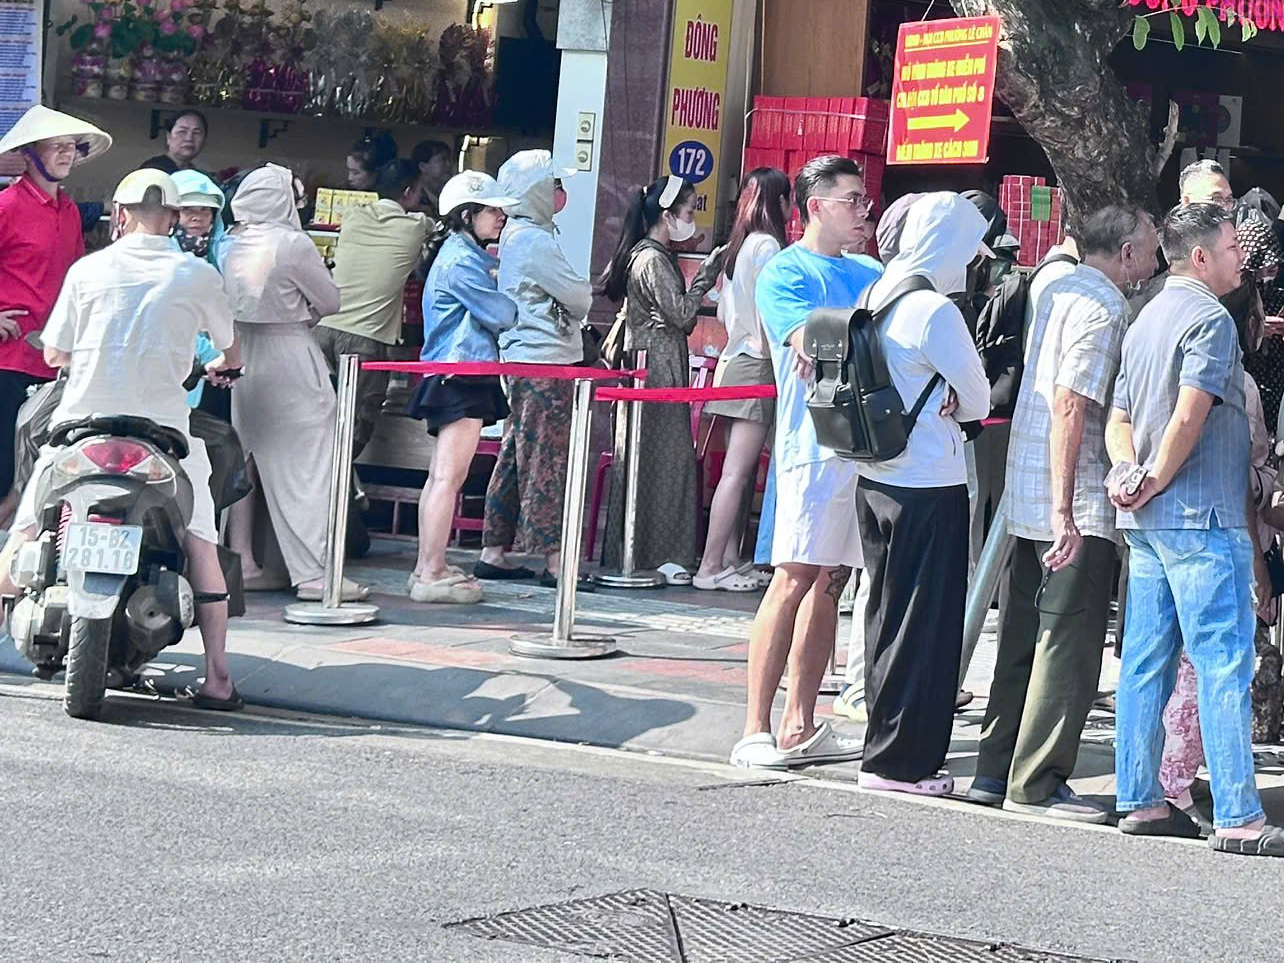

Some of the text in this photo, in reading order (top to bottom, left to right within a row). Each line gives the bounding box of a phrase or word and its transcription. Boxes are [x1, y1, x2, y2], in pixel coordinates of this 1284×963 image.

[684, 14, 719, 62] ĐÔNG
[671, 86, 721, 131] PHƯƠNG
[678, 148, 706, 176] 172
